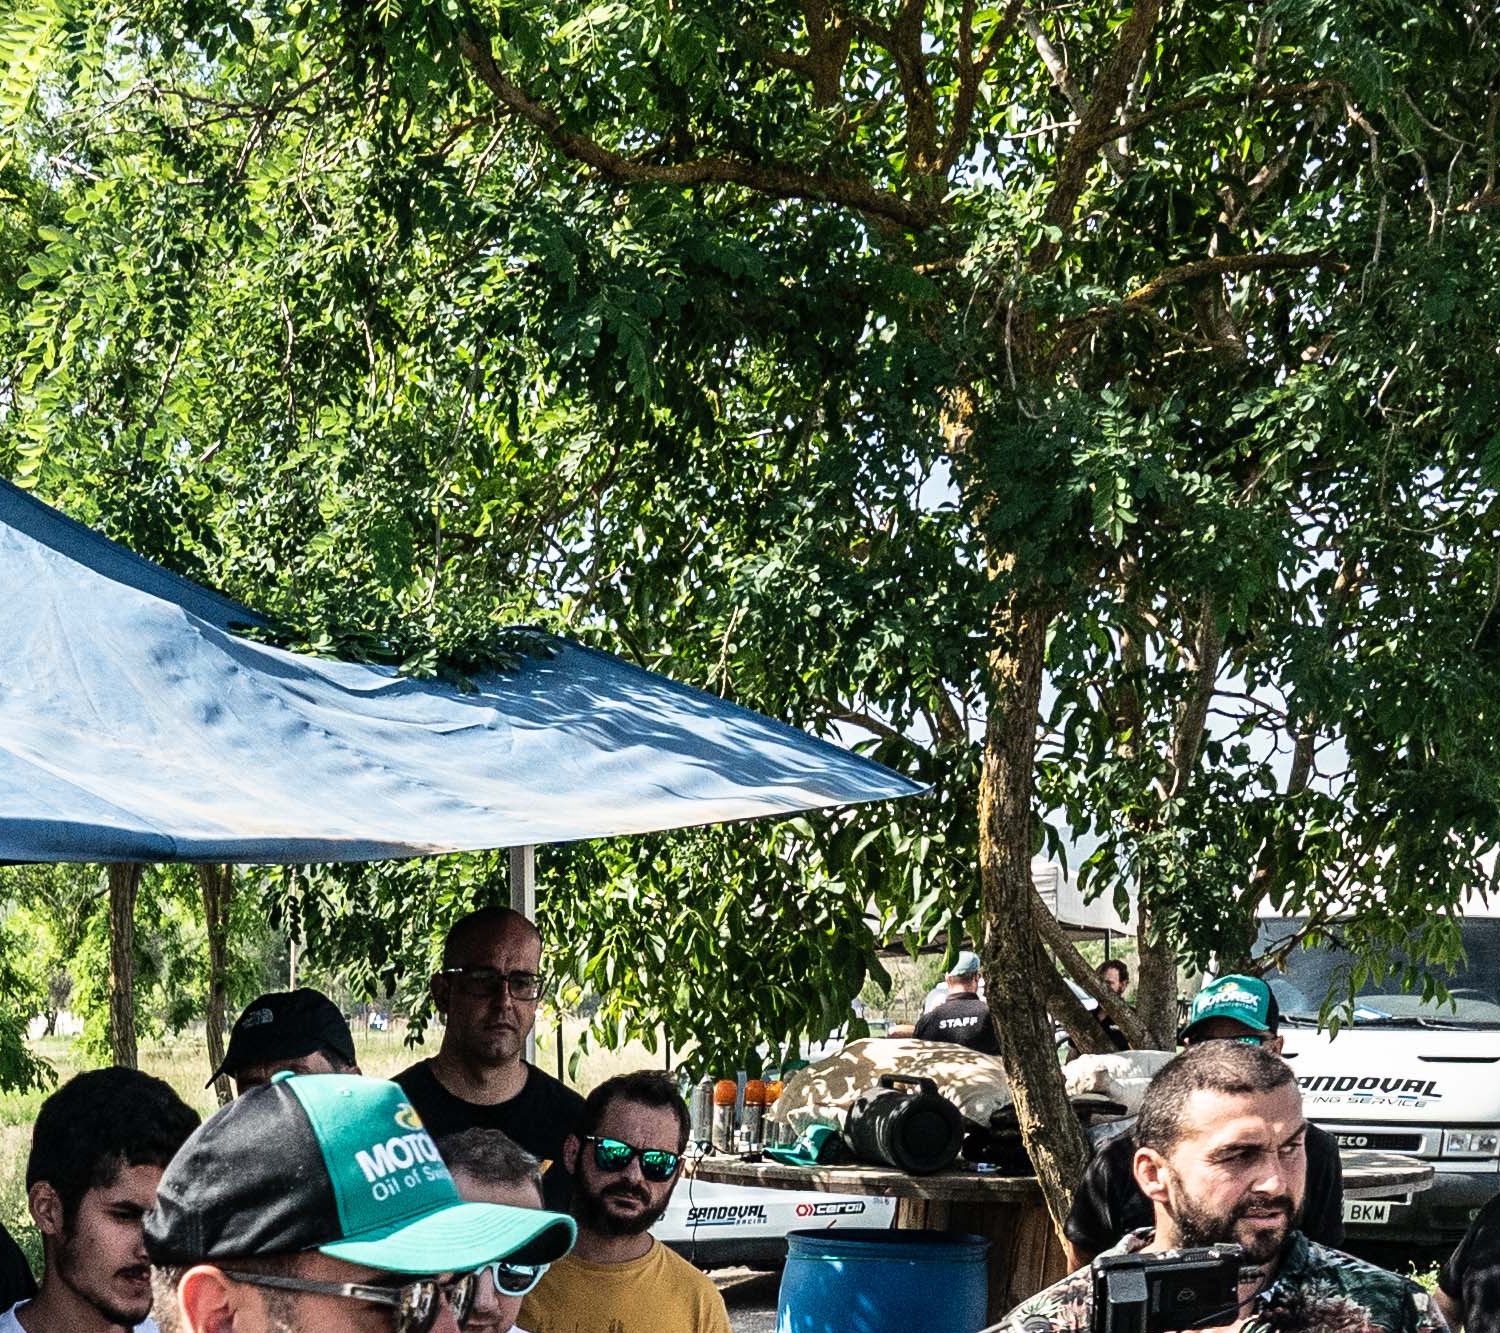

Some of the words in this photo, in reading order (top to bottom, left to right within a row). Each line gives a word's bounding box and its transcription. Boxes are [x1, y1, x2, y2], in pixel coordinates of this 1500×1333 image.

[938, 1016, 979, 1030] STAFF
[1296, 1075, 1443, 1099] ANDOVAL
[1347, 1096, 1428, 1108] SERVICE
[1335, 1135, 1368, 1147] ECO
[355, 1132, 444, 1183] MOTO
[372, 1177, 401, 1202] Oil
[403, 1168, 422, 1189] of
[686, 1203, 767, 1222] SANDOVAL
[1350, 1204, 1386, 1221] BKM
